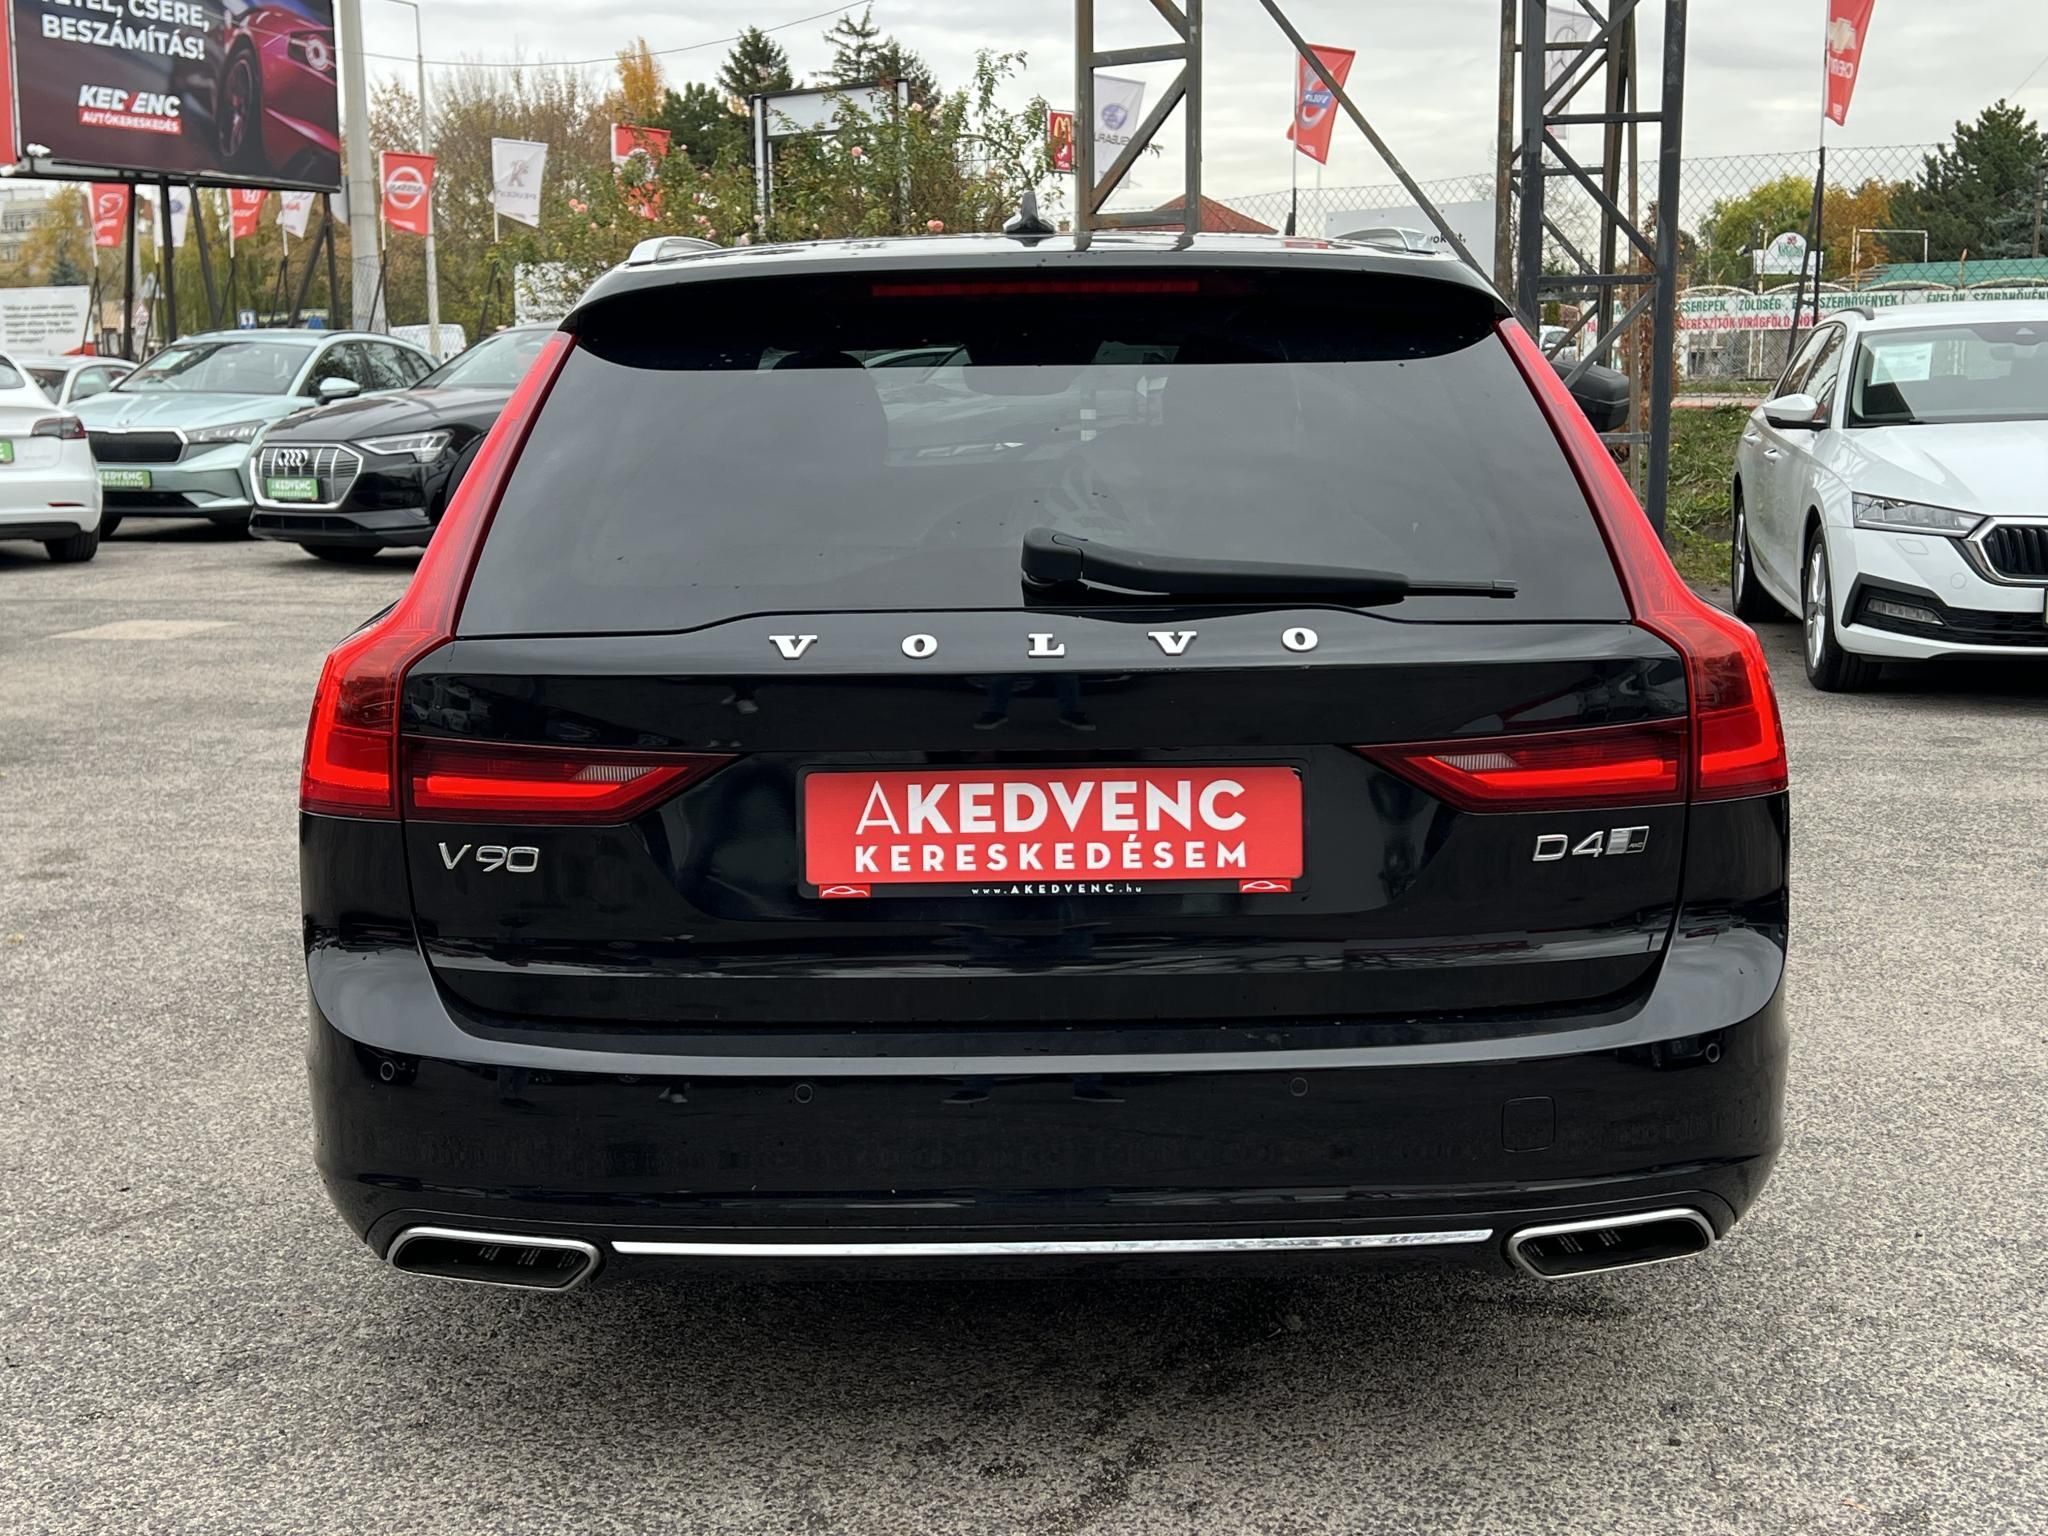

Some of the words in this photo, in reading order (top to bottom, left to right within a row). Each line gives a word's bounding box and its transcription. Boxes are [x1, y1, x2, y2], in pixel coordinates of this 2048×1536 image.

[128, 0, 210, 33] CSERE,
[42, 13, 206, 61] BESZÁMÍTÁS!
[769, 627, 1319, 660] VOLVO
[855, 835, 1247, 873] KERESKEDÉSEM
[1532, 830, 1604, 861] D4
[972, 883, 1142, 895] www.AKEDVENC.hu
